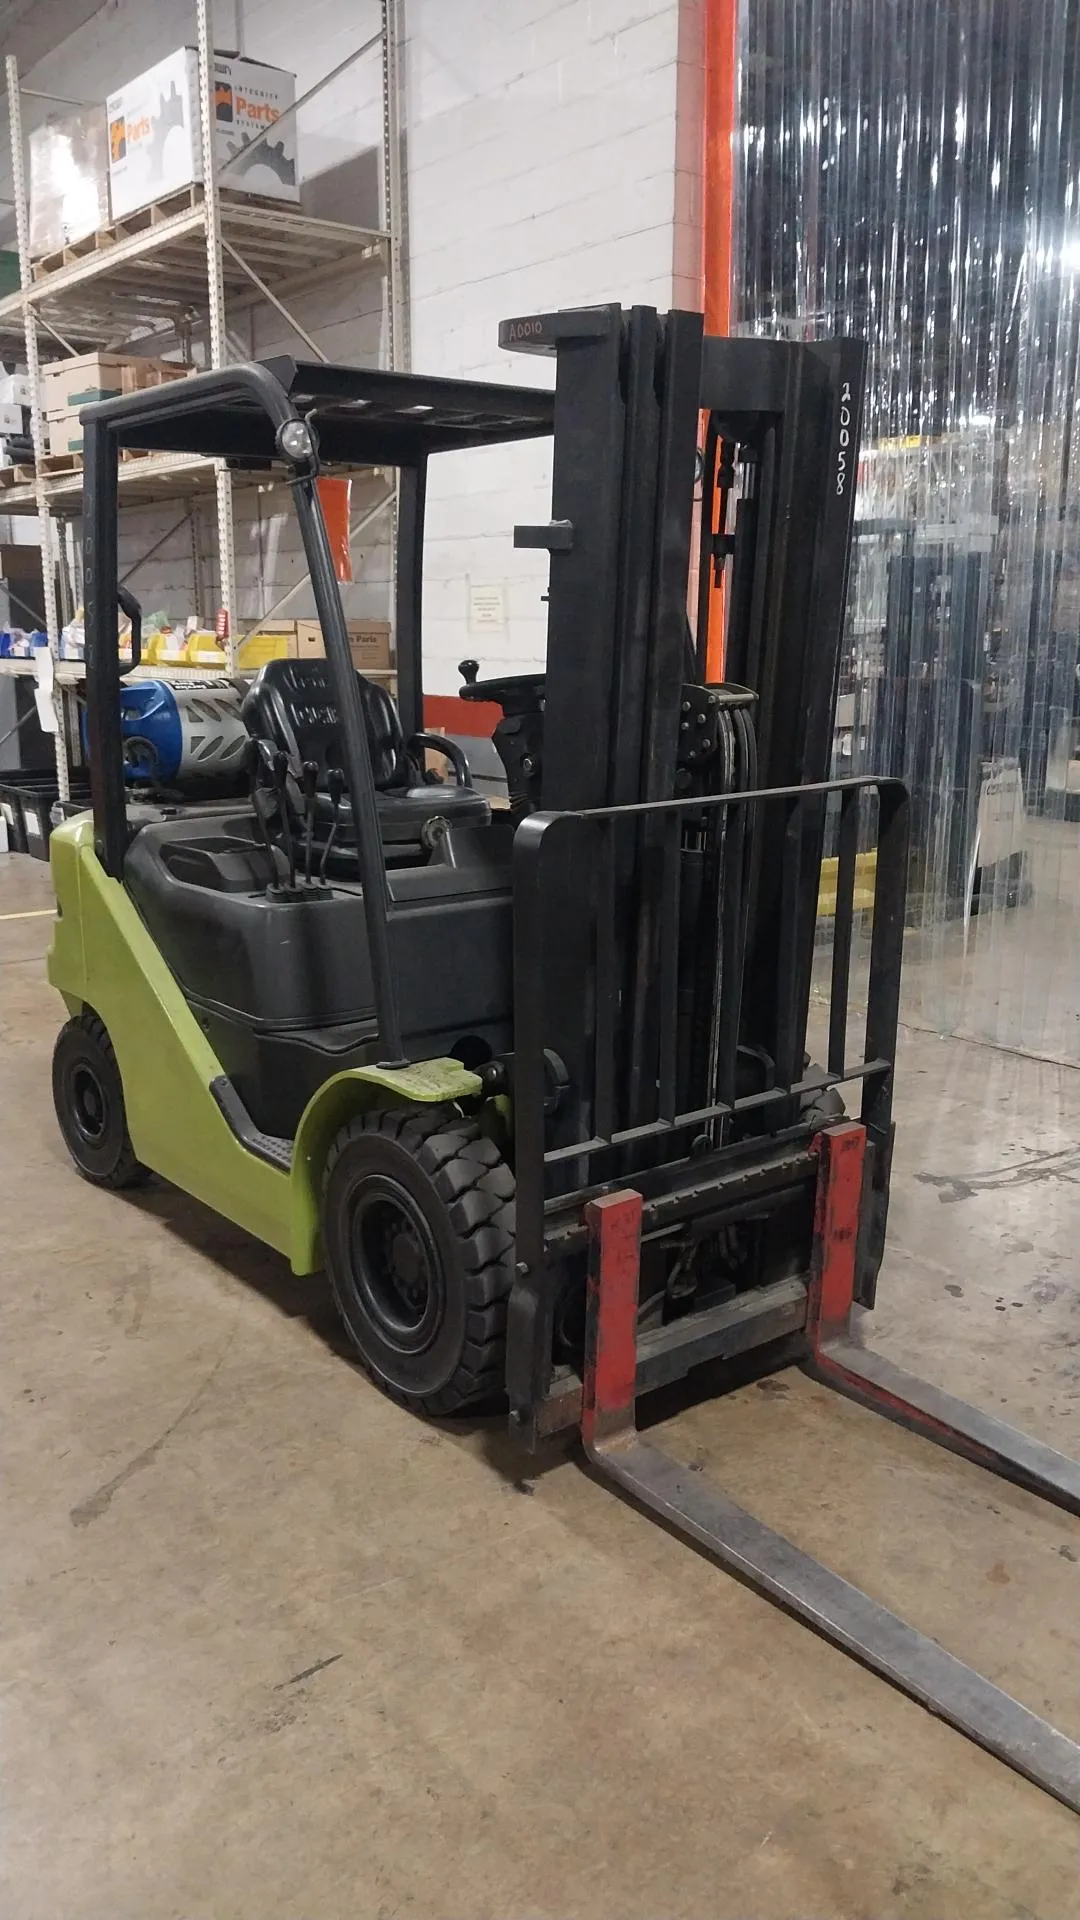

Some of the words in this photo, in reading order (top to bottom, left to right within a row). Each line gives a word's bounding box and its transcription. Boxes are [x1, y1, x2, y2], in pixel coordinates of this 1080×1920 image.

[236, 95, 281, 122] Parts
[127, 116, 150, 142] Parts
[836, 382, 851, 495] 20058
